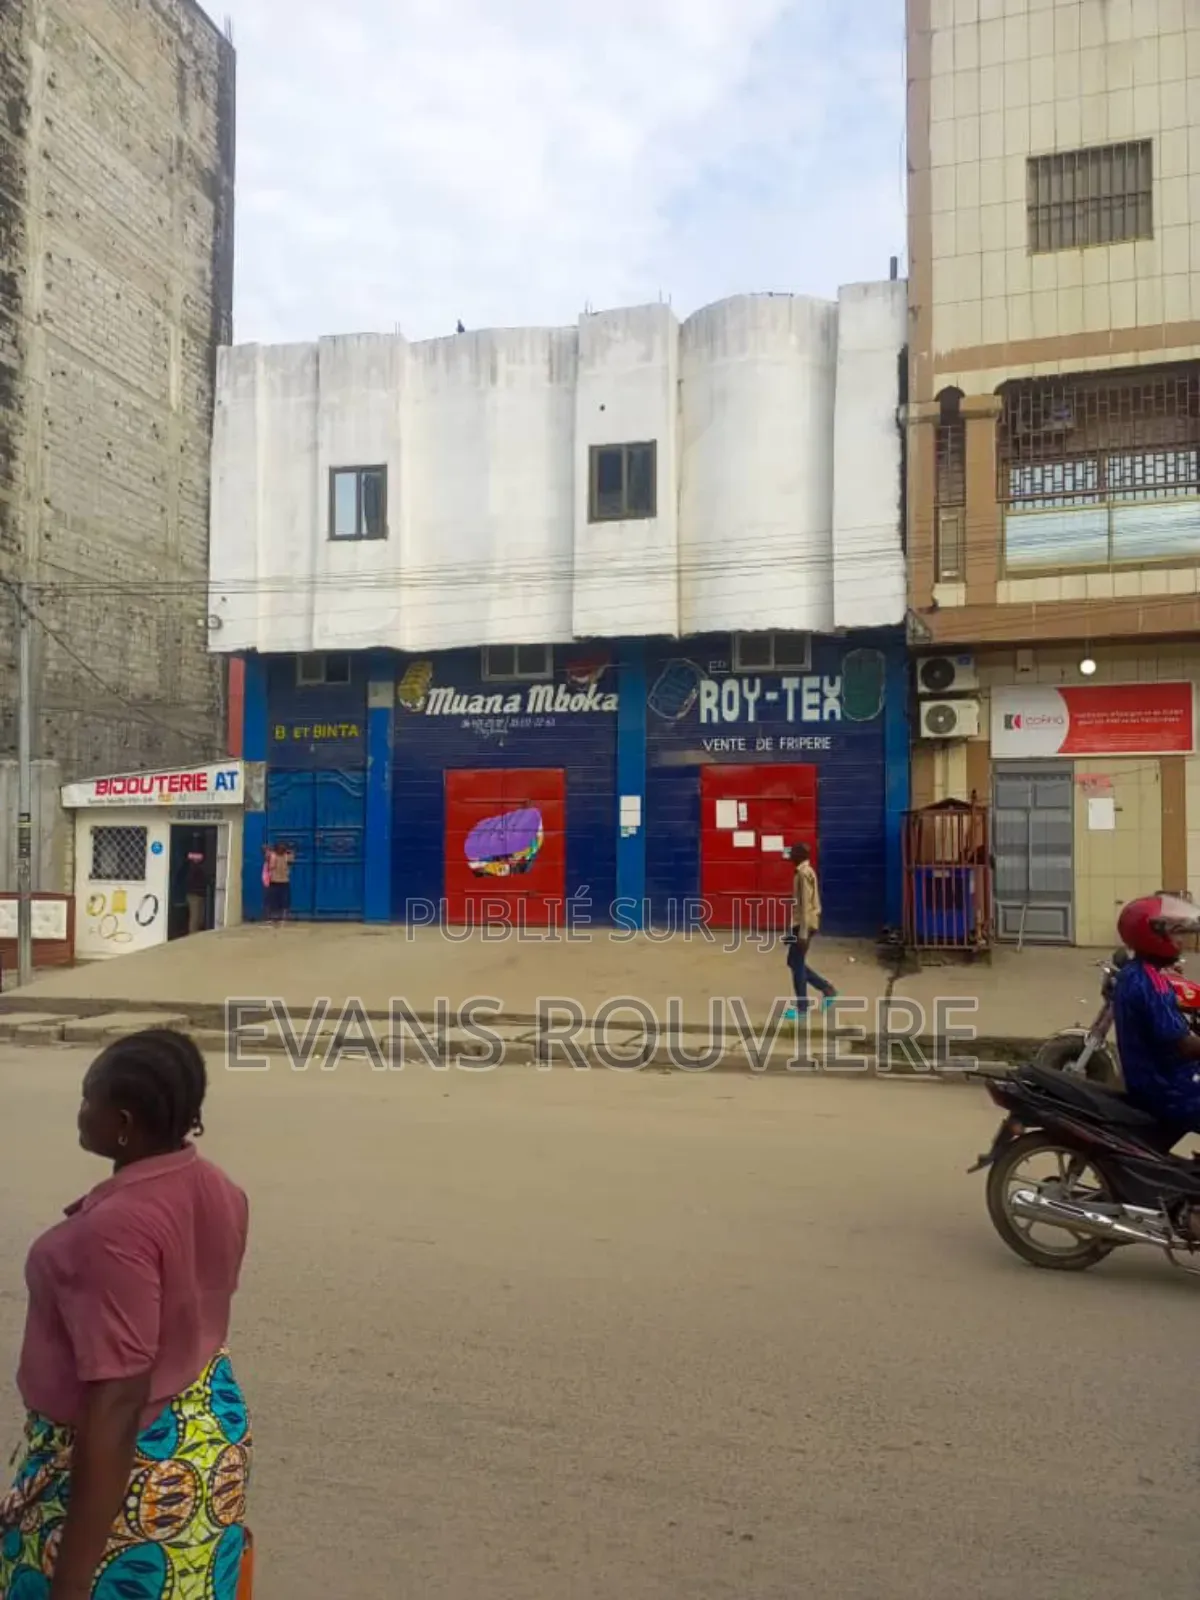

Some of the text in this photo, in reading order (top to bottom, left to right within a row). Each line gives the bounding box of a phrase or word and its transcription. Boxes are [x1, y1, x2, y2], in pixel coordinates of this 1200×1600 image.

[425, 684, 619, 716] Muana Mboka
[700, 675, 842, 724] ROY-TEX
[312, 724, 359, 739] BINTA
[702, 736, 832, 751] VENTE DE FRIPERIE
[95, 770, 239, 796] BIJOUTERIE AT
